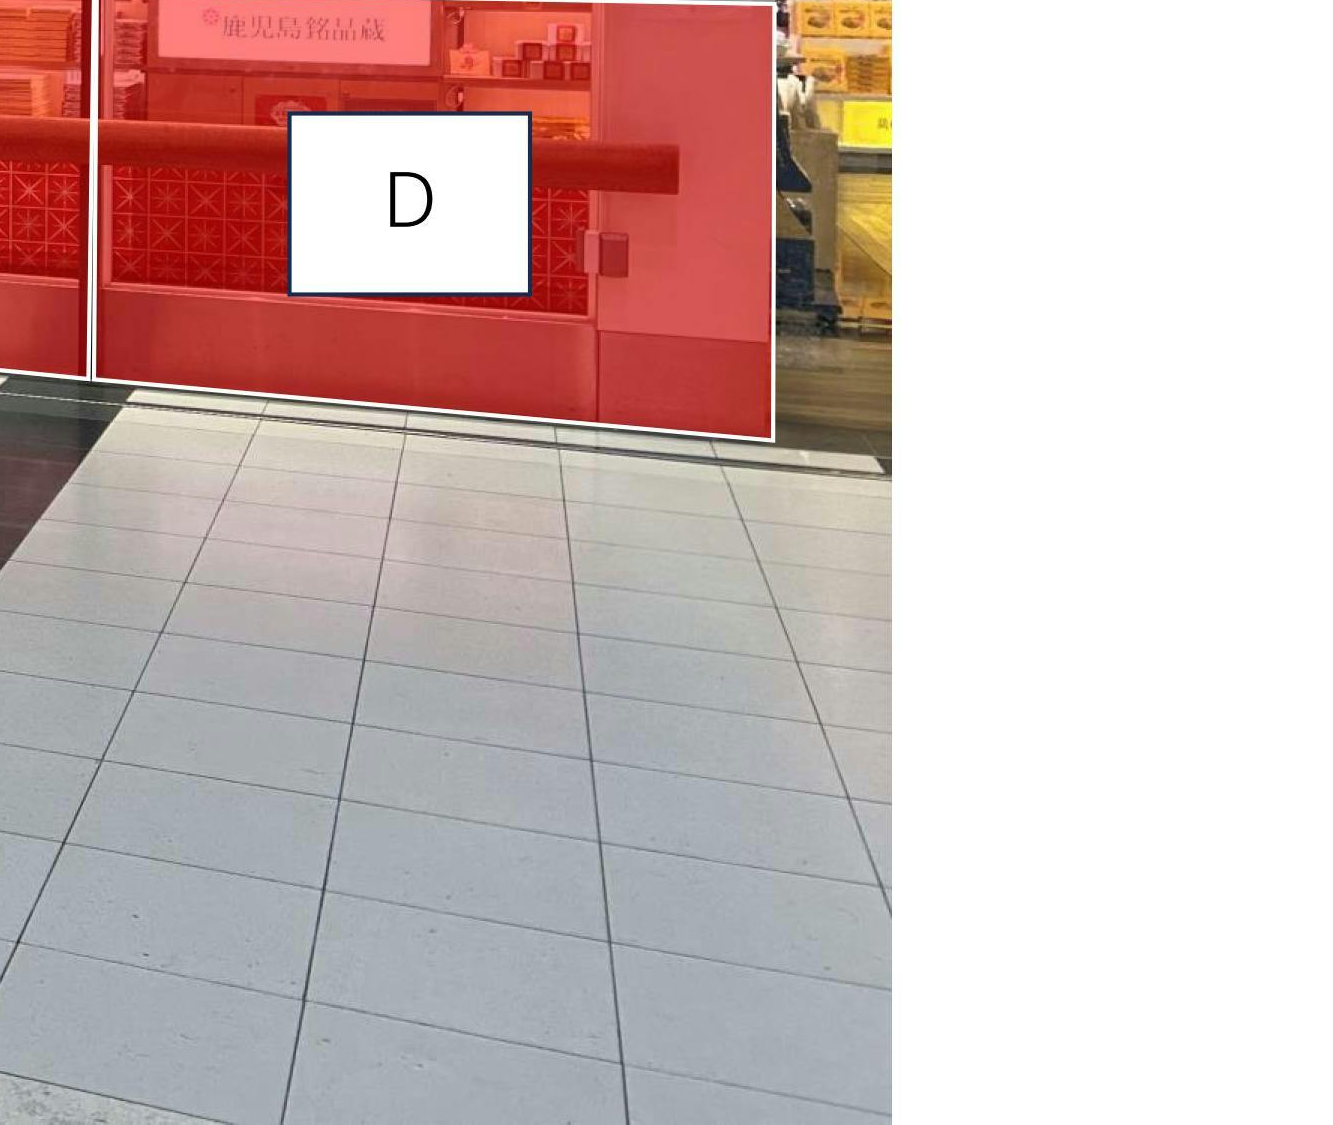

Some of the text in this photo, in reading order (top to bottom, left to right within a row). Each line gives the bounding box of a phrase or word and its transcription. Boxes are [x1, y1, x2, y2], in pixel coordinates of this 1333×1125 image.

[223, 15, 386, 43] 鹿児島銘品蔵
